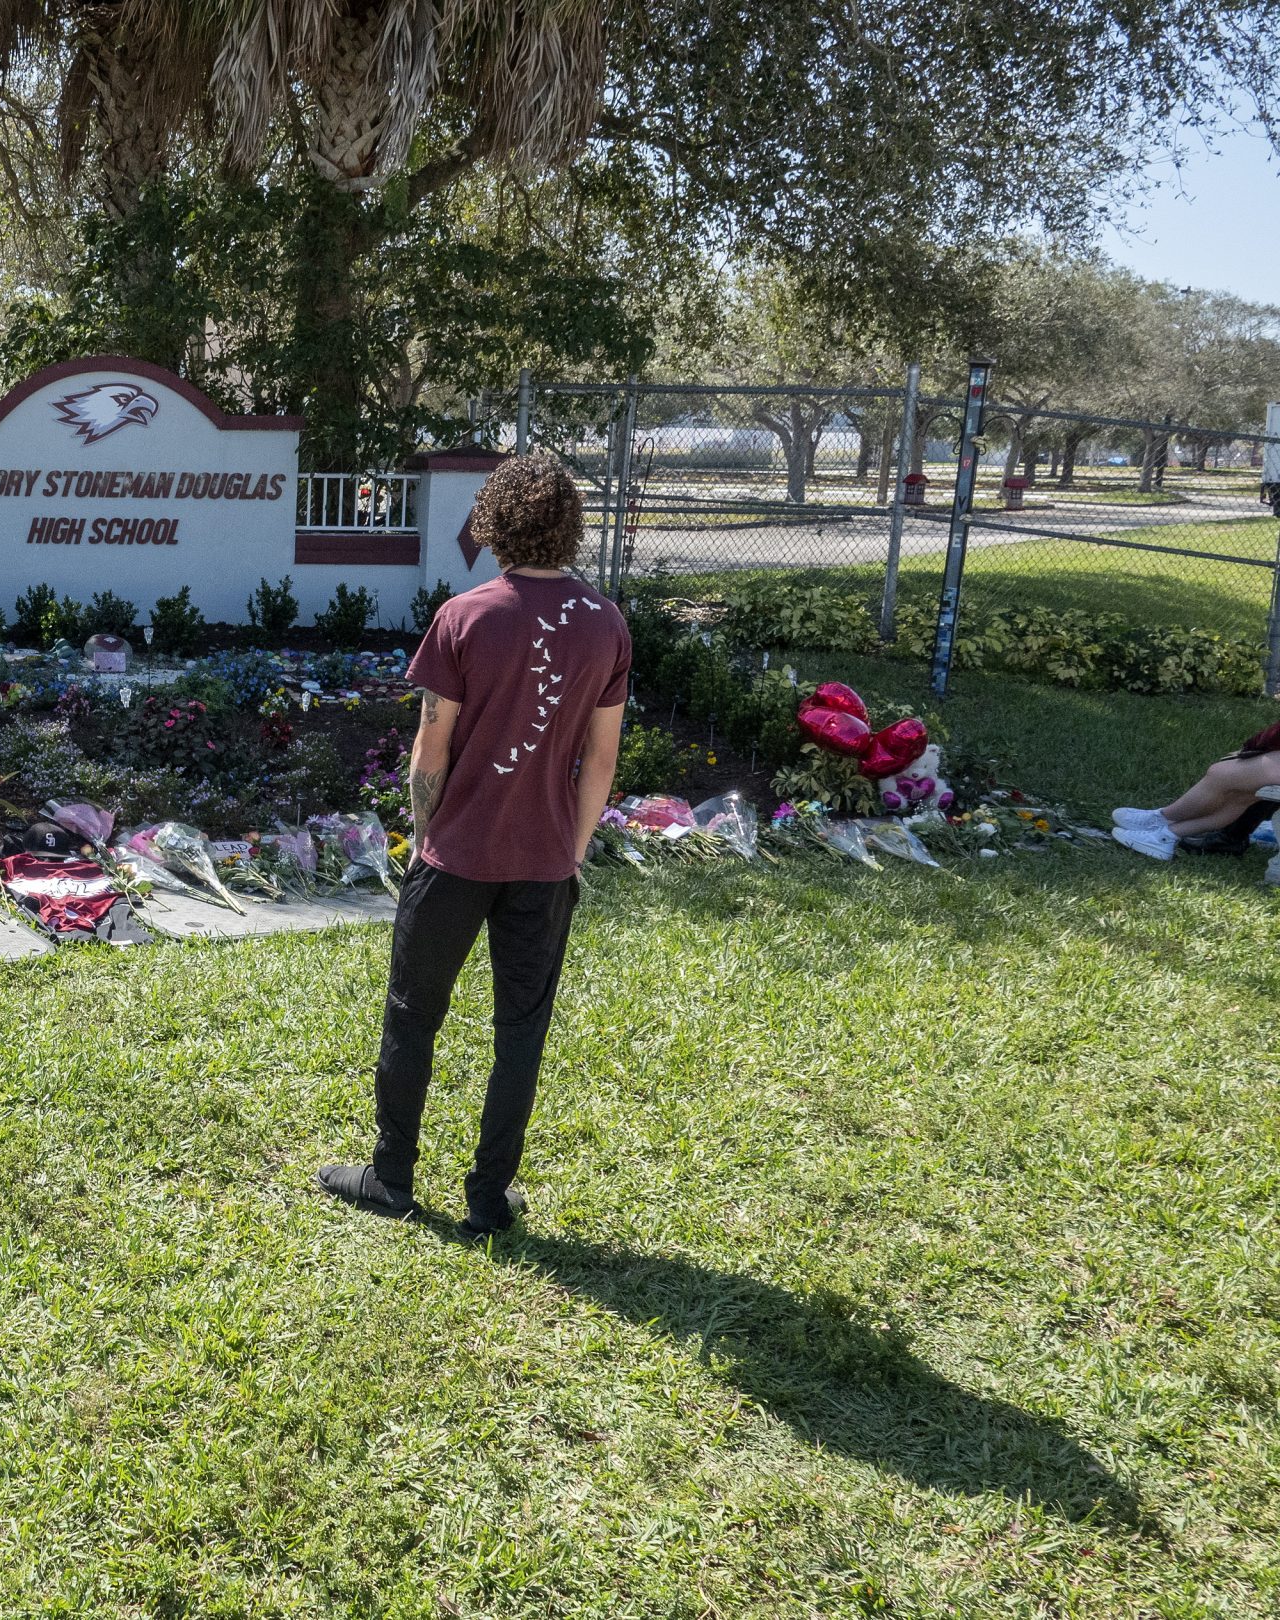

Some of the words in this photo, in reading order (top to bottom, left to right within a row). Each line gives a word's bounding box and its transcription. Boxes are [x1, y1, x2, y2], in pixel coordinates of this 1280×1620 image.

[42, 470, 175, 499] STONEMAN
[175, 472, 286, 500] DOUGLAS
[27, 517, 86, 544] HIGH
[88, 517, 179, 545] SCHOOL
[214, 843, 248, 852] LEAD
